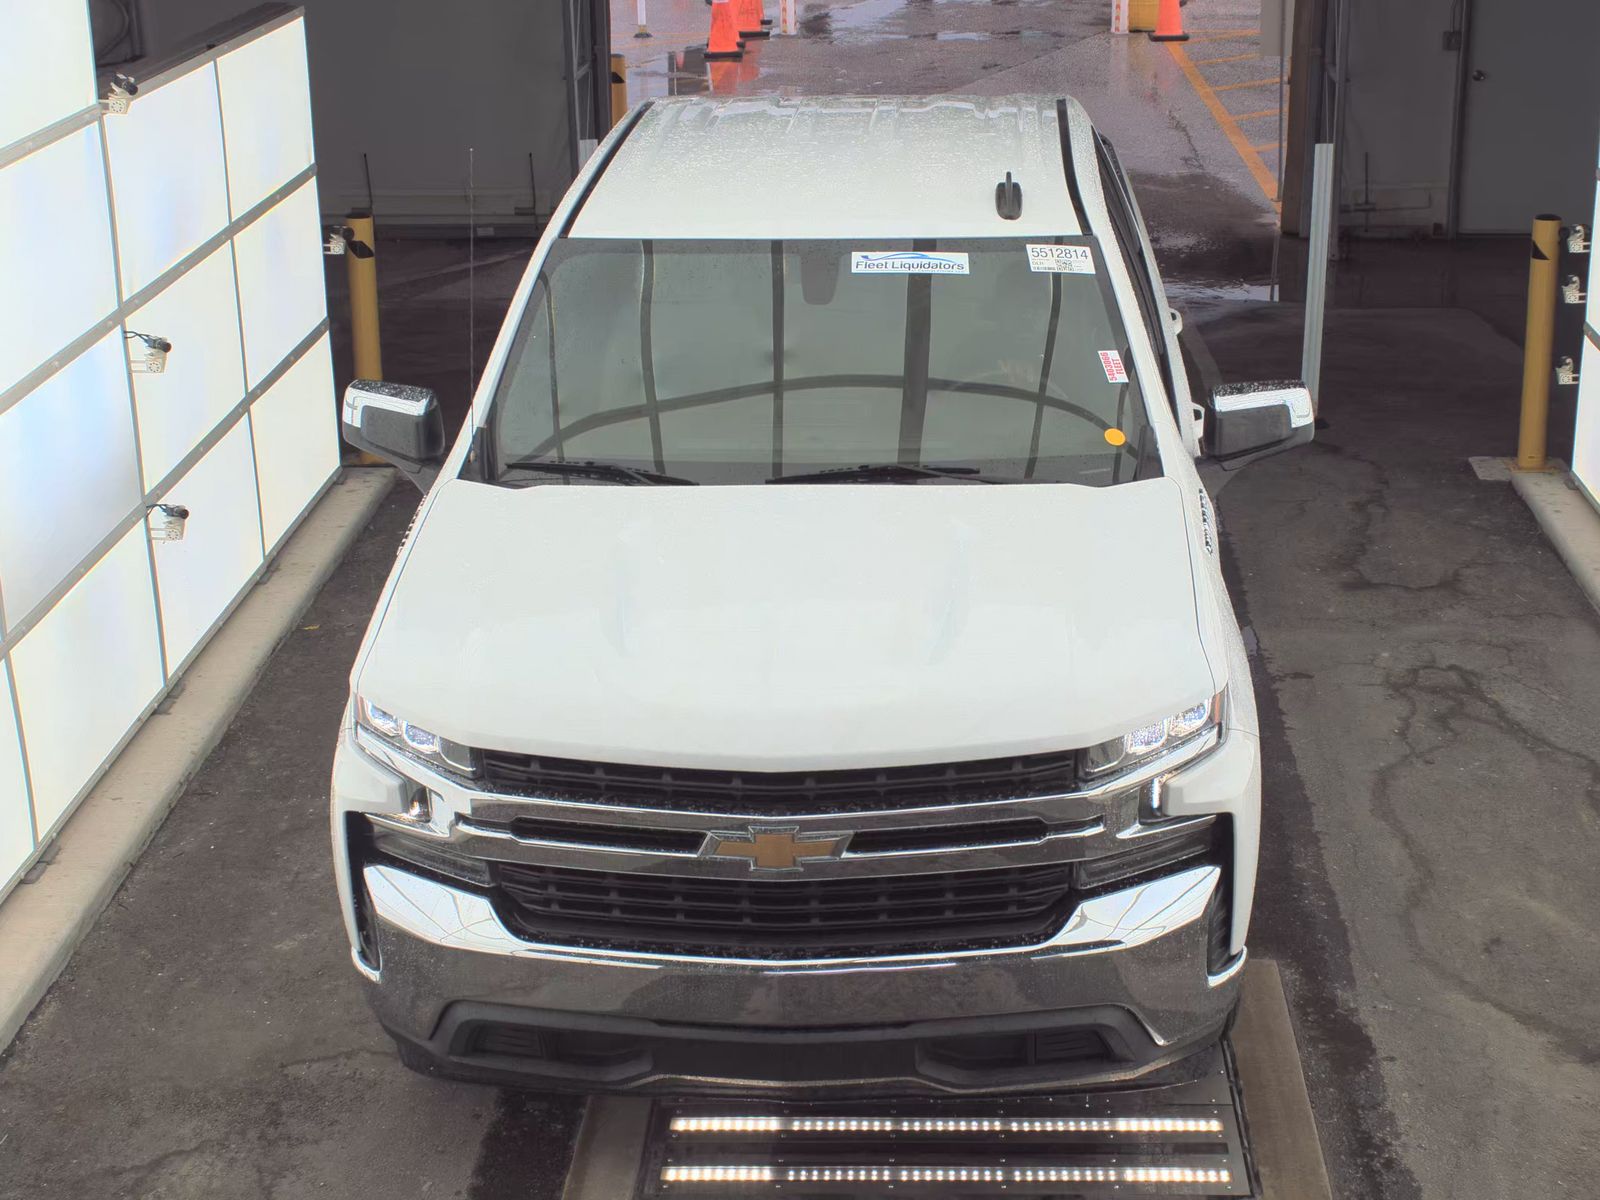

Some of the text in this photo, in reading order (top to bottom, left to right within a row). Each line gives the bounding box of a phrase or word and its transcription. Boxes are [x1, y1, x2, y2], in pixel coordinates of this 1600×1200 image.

[1031, 247, 1088, 260] 5512814
[855, 260, 889, 269] Fleet
[891, 261, 965, 271] Liquidators
[1111, 358, 1125, 375] FLEET
